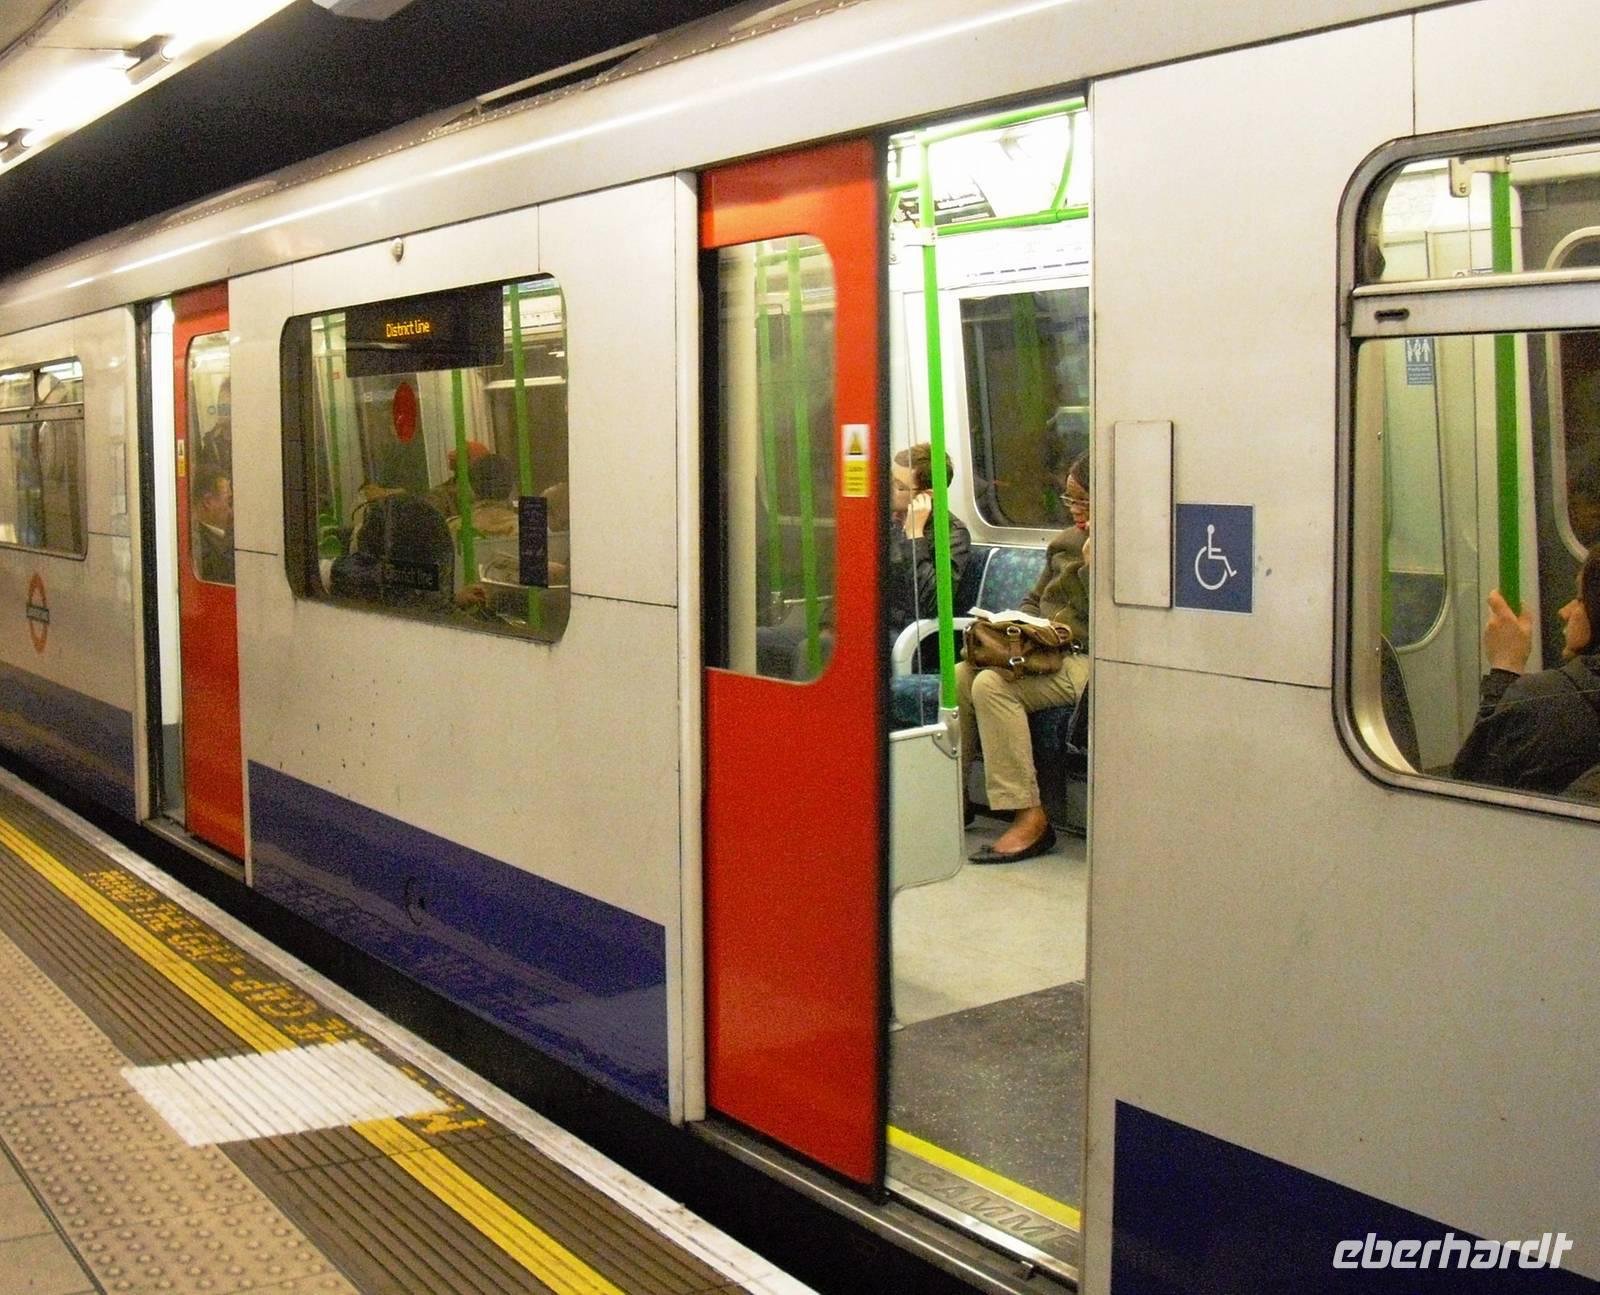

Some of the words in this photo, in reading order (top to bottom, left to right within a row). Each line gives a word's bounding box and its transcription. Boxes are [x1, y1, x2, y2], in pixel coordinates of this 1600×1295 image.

[386, 321, 414, 338] District
[414, 319, 430, 334] line
[82, 869, 159, 904] MIND
[128, 902, 200, 931] THE
[166, 931, 245, 961] GAP
[228, 980, 319, 1018] GAP
